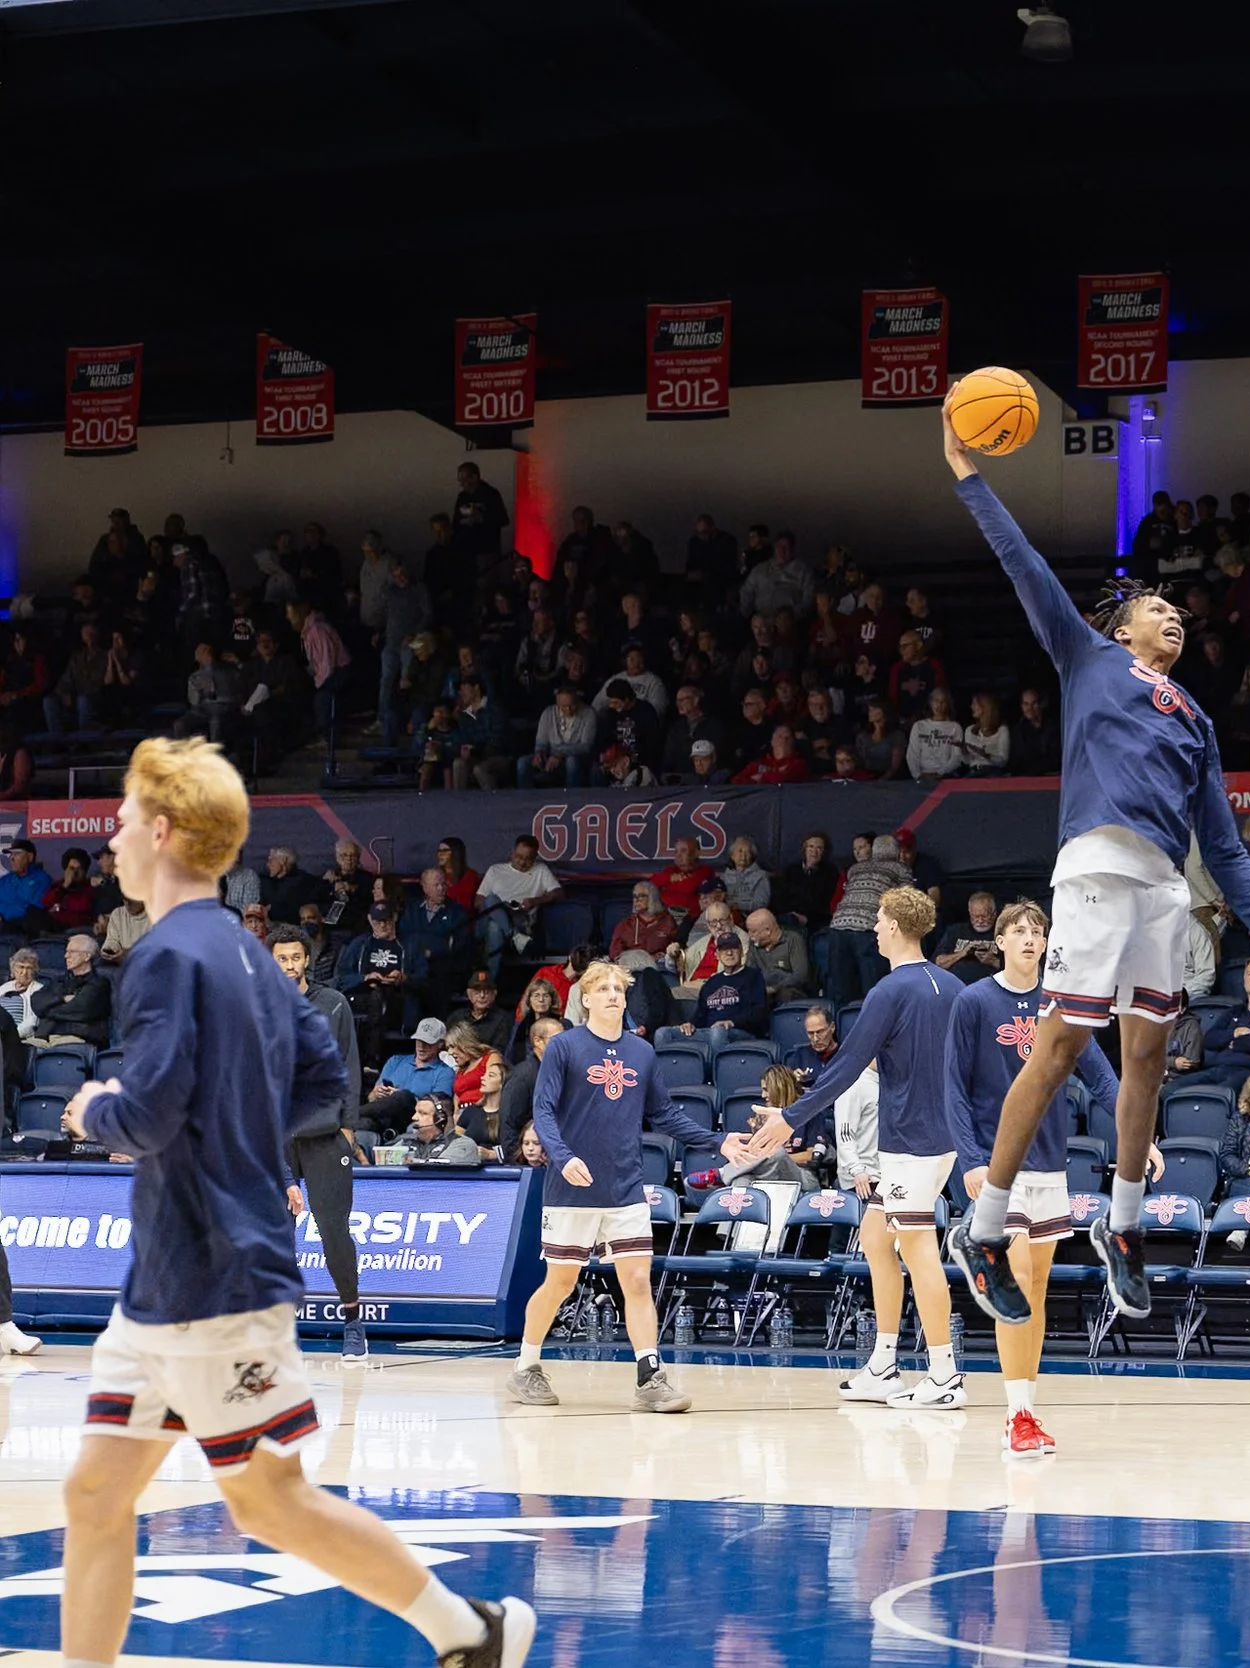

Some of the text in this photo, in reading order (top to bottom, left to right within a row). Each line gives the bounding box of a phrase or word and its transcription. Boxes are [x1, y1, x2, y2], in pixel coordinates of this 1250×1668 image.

[1102, 292, 1142, 307] MARCH
[884, 306, 924, 320] MARCH
[1106, 303, 1160, 319] MADNESS
[668, 320, 706, 334] MARCH
[888, 317, 941, 333] MADNESS
[476, 333, 513, 348] MARCH
[672, 331, 723, 346] MADNESS
[480, 343, 529, 361] MADNESS
[86, 362, 120, 377] MARCH
[1088, 351, 1156, 383] 2017
[89, 372, 135, 388] MADNESS
[872, 365, 938, 395] 2013
[656, 379, 719, 407] 2012
[463, 390, 524, 420] 2010
[263, 403, 327, 433] 2008
[72, 416, 134, 444] 2005
[32, 816, 116, 834] SECTION B
[532, 803, 727, 861] GAELS
[995, 1016, 1037, 1061] SM
[587, 1058, 638, 1100] SMC
[99, 1213, 132, 1249] to
[356, 1247, 443, 1274] pavilion
